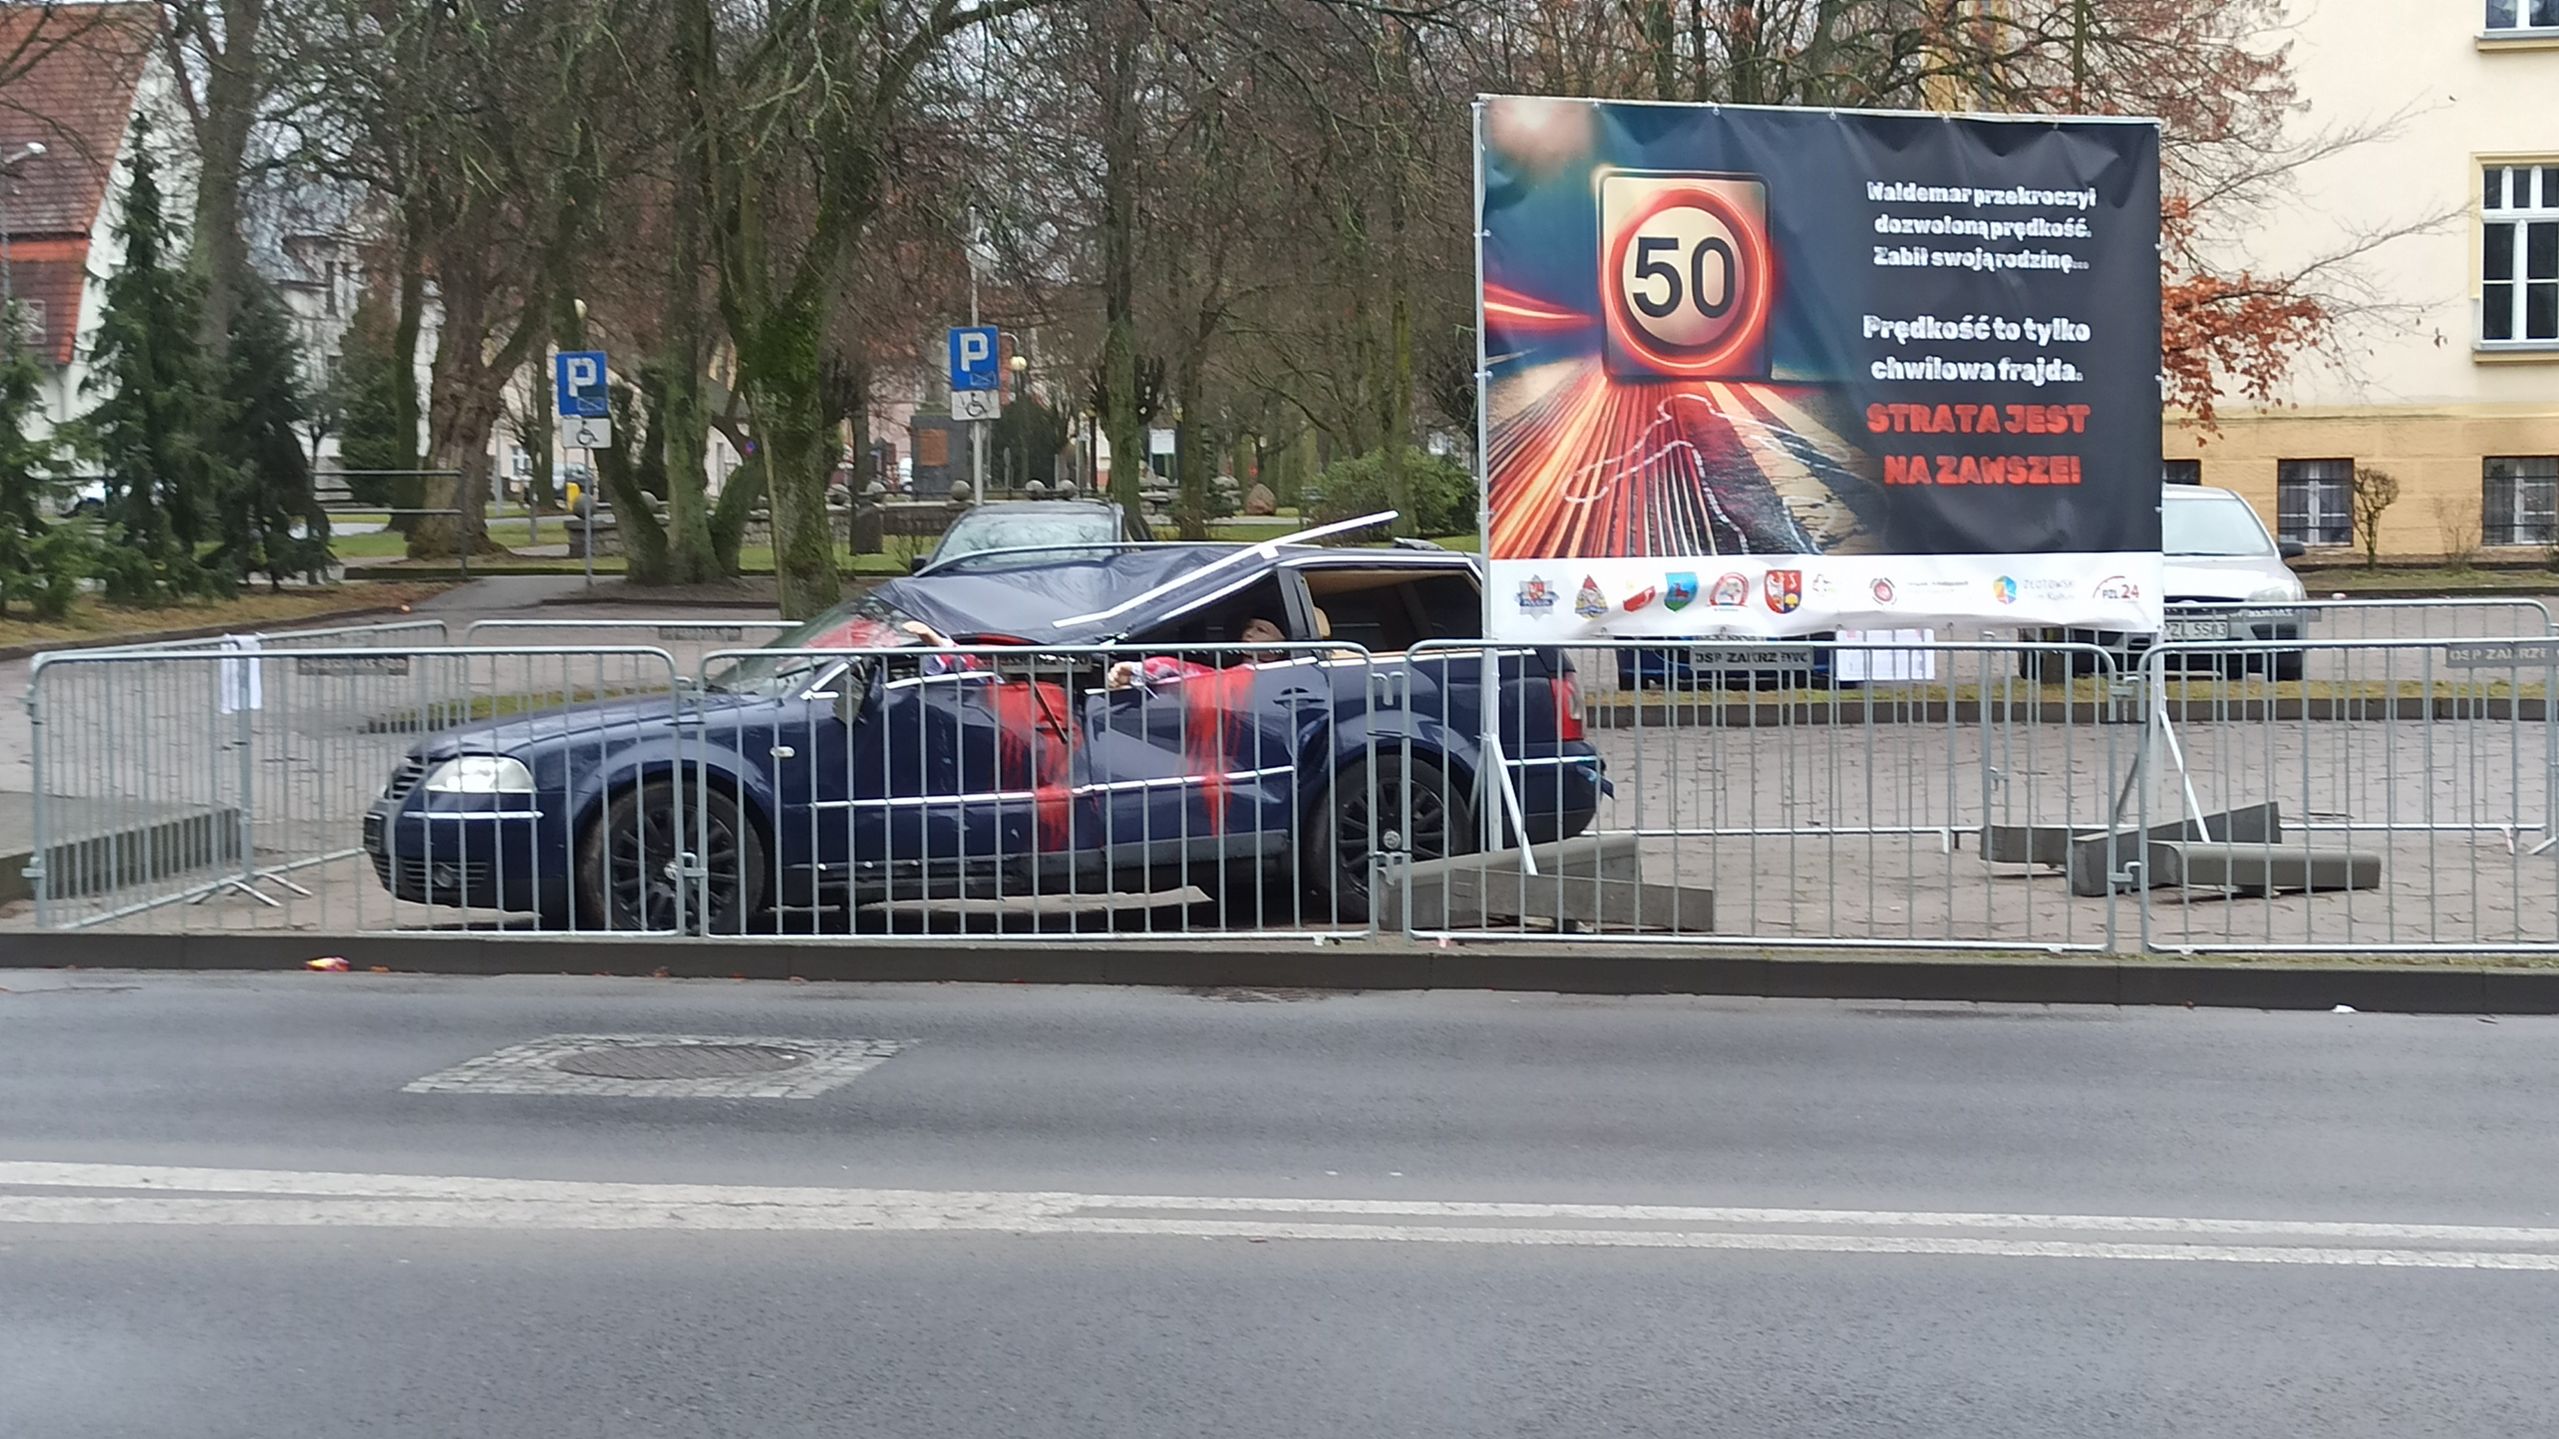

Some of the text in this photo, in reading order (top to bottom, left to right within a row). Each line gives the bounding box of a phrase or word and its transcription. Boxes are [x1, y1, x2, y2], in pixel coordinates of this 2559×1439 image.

[1866, 181, 2097, 210] Waldemar przekroczył
[1874, 214, 2092, 241] dozwoloną prędkość.
[1873, 246, 2089, 273] Zabił swoją rodzinę...
[1632, 236, 1736, 319] 50
[1862, 315, 2091, 346] Prędkość to tylko
[959, 332, 989, 372] P
[567, 357, 598, 398] P
[1871, 356, 2083, 387] chwilowa frajda.
[1866, 403, 2092, 434] STRATA JEST
[1884, 454, 2082, 485] NA ZAWSZE!
[2121, 584, 2140, 599] 24
